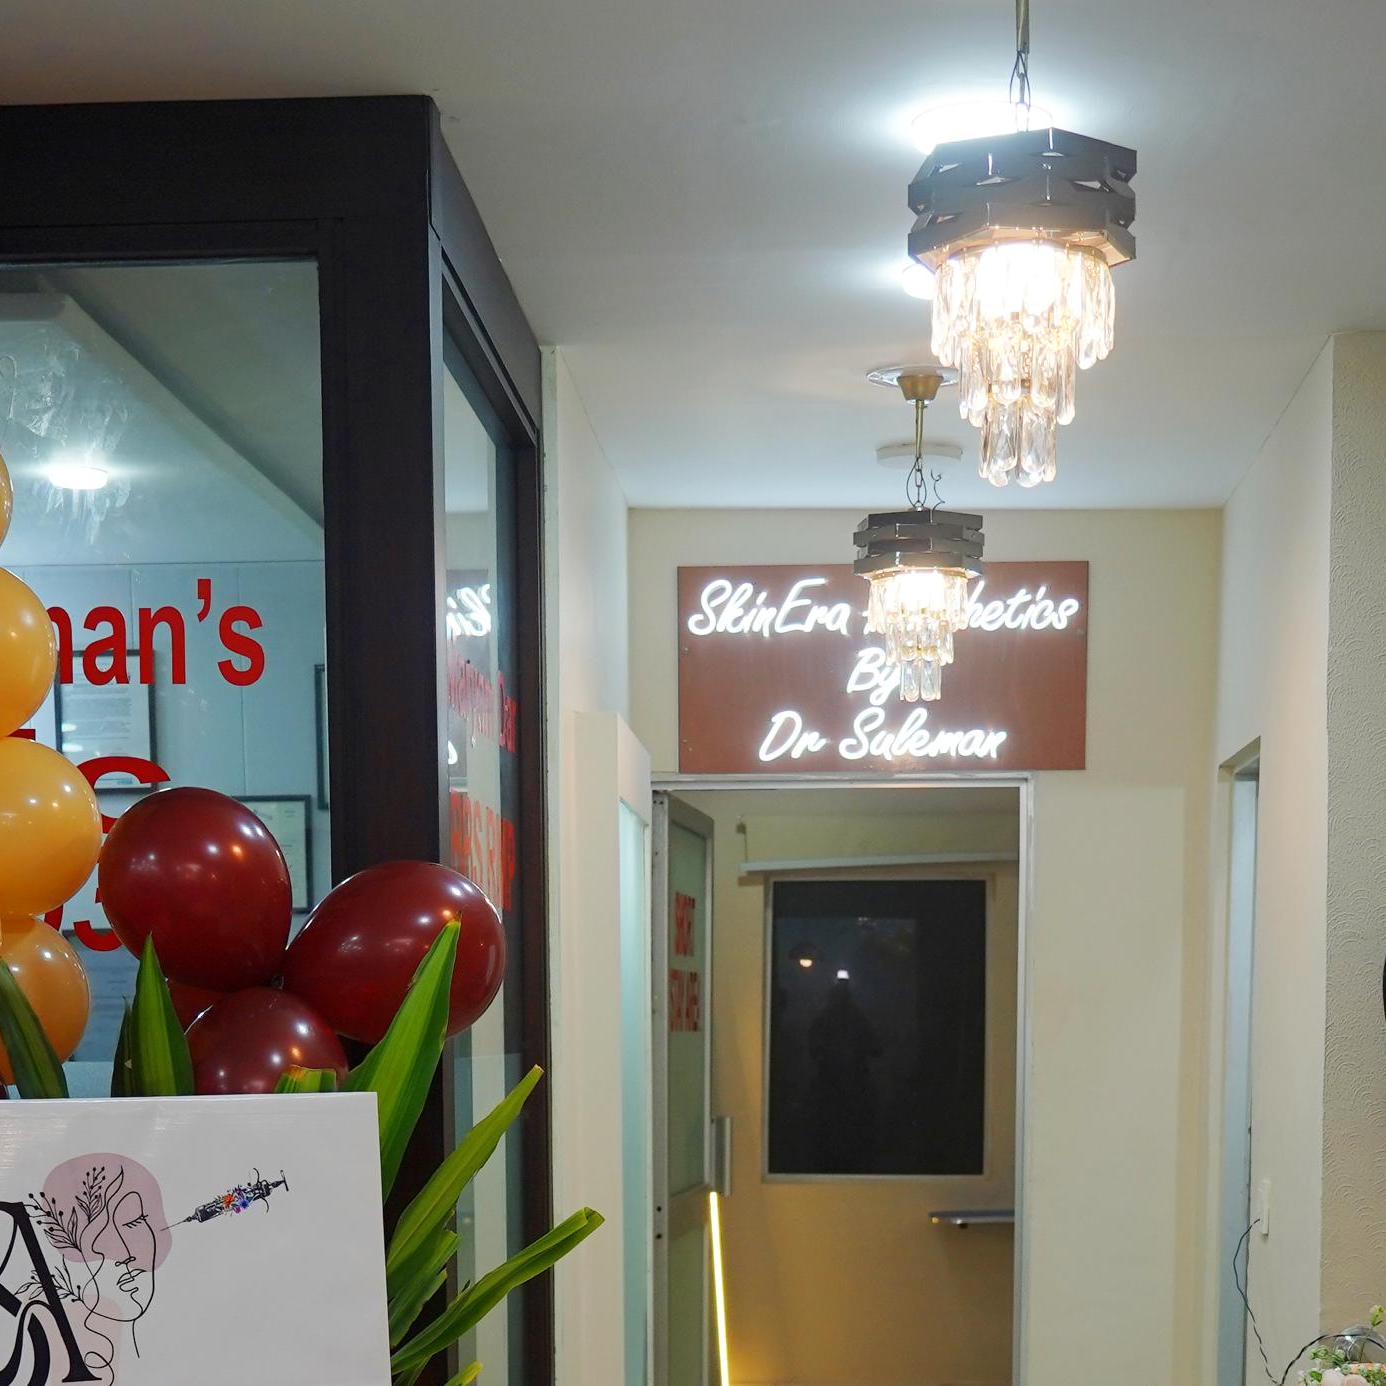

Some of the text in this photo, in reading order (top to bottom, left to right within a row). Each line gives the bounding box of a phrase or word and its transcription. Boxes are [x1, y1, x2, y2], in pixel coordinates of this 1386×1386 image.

[688, 578, 850, 636] SkinEra
[758, 706, 1007, 762] Dr Suleman
